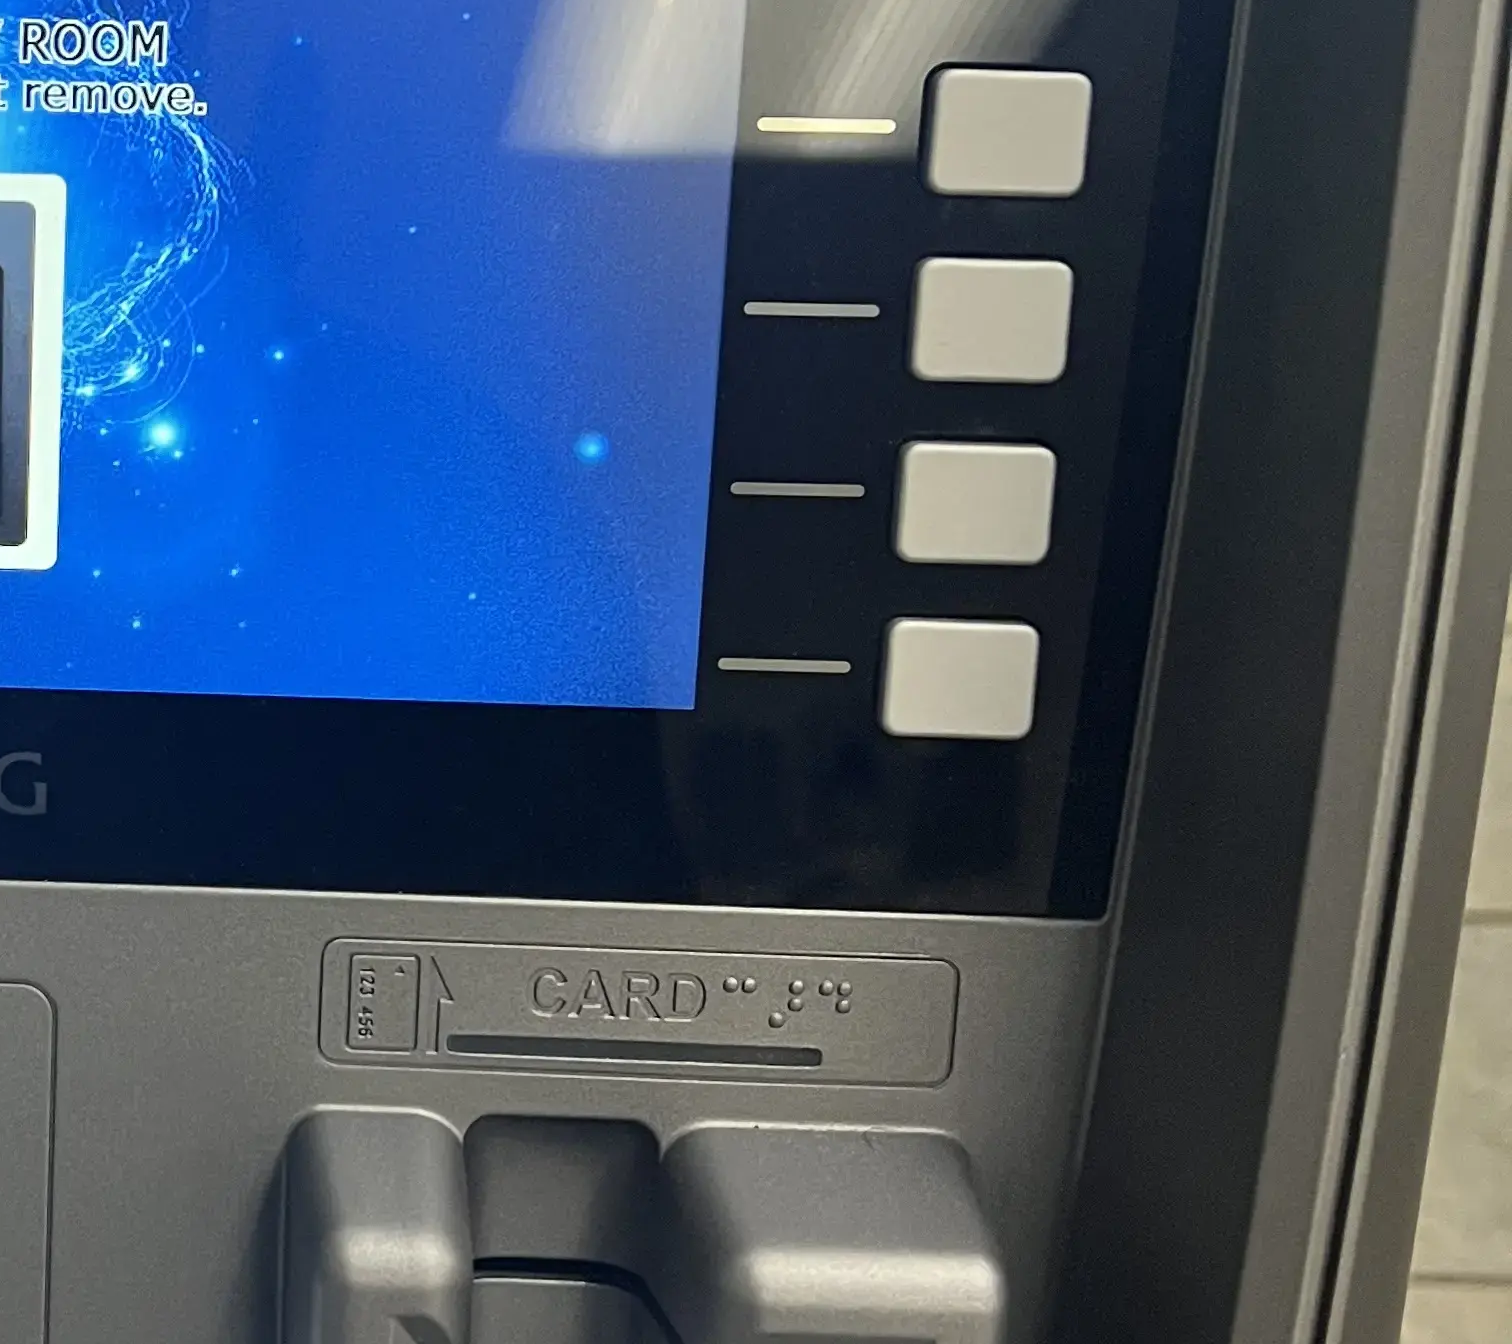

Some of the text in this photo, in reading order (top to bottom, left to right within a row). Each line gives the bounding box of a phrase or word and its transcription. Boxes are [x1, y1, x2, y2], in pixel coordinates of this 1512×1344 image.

[18, 19, 170, 67] ROOM
[22, 83, 208, 116] remove.
[359, 966, 376, 997] 123
[529, 967, 708, 1022] CARD
